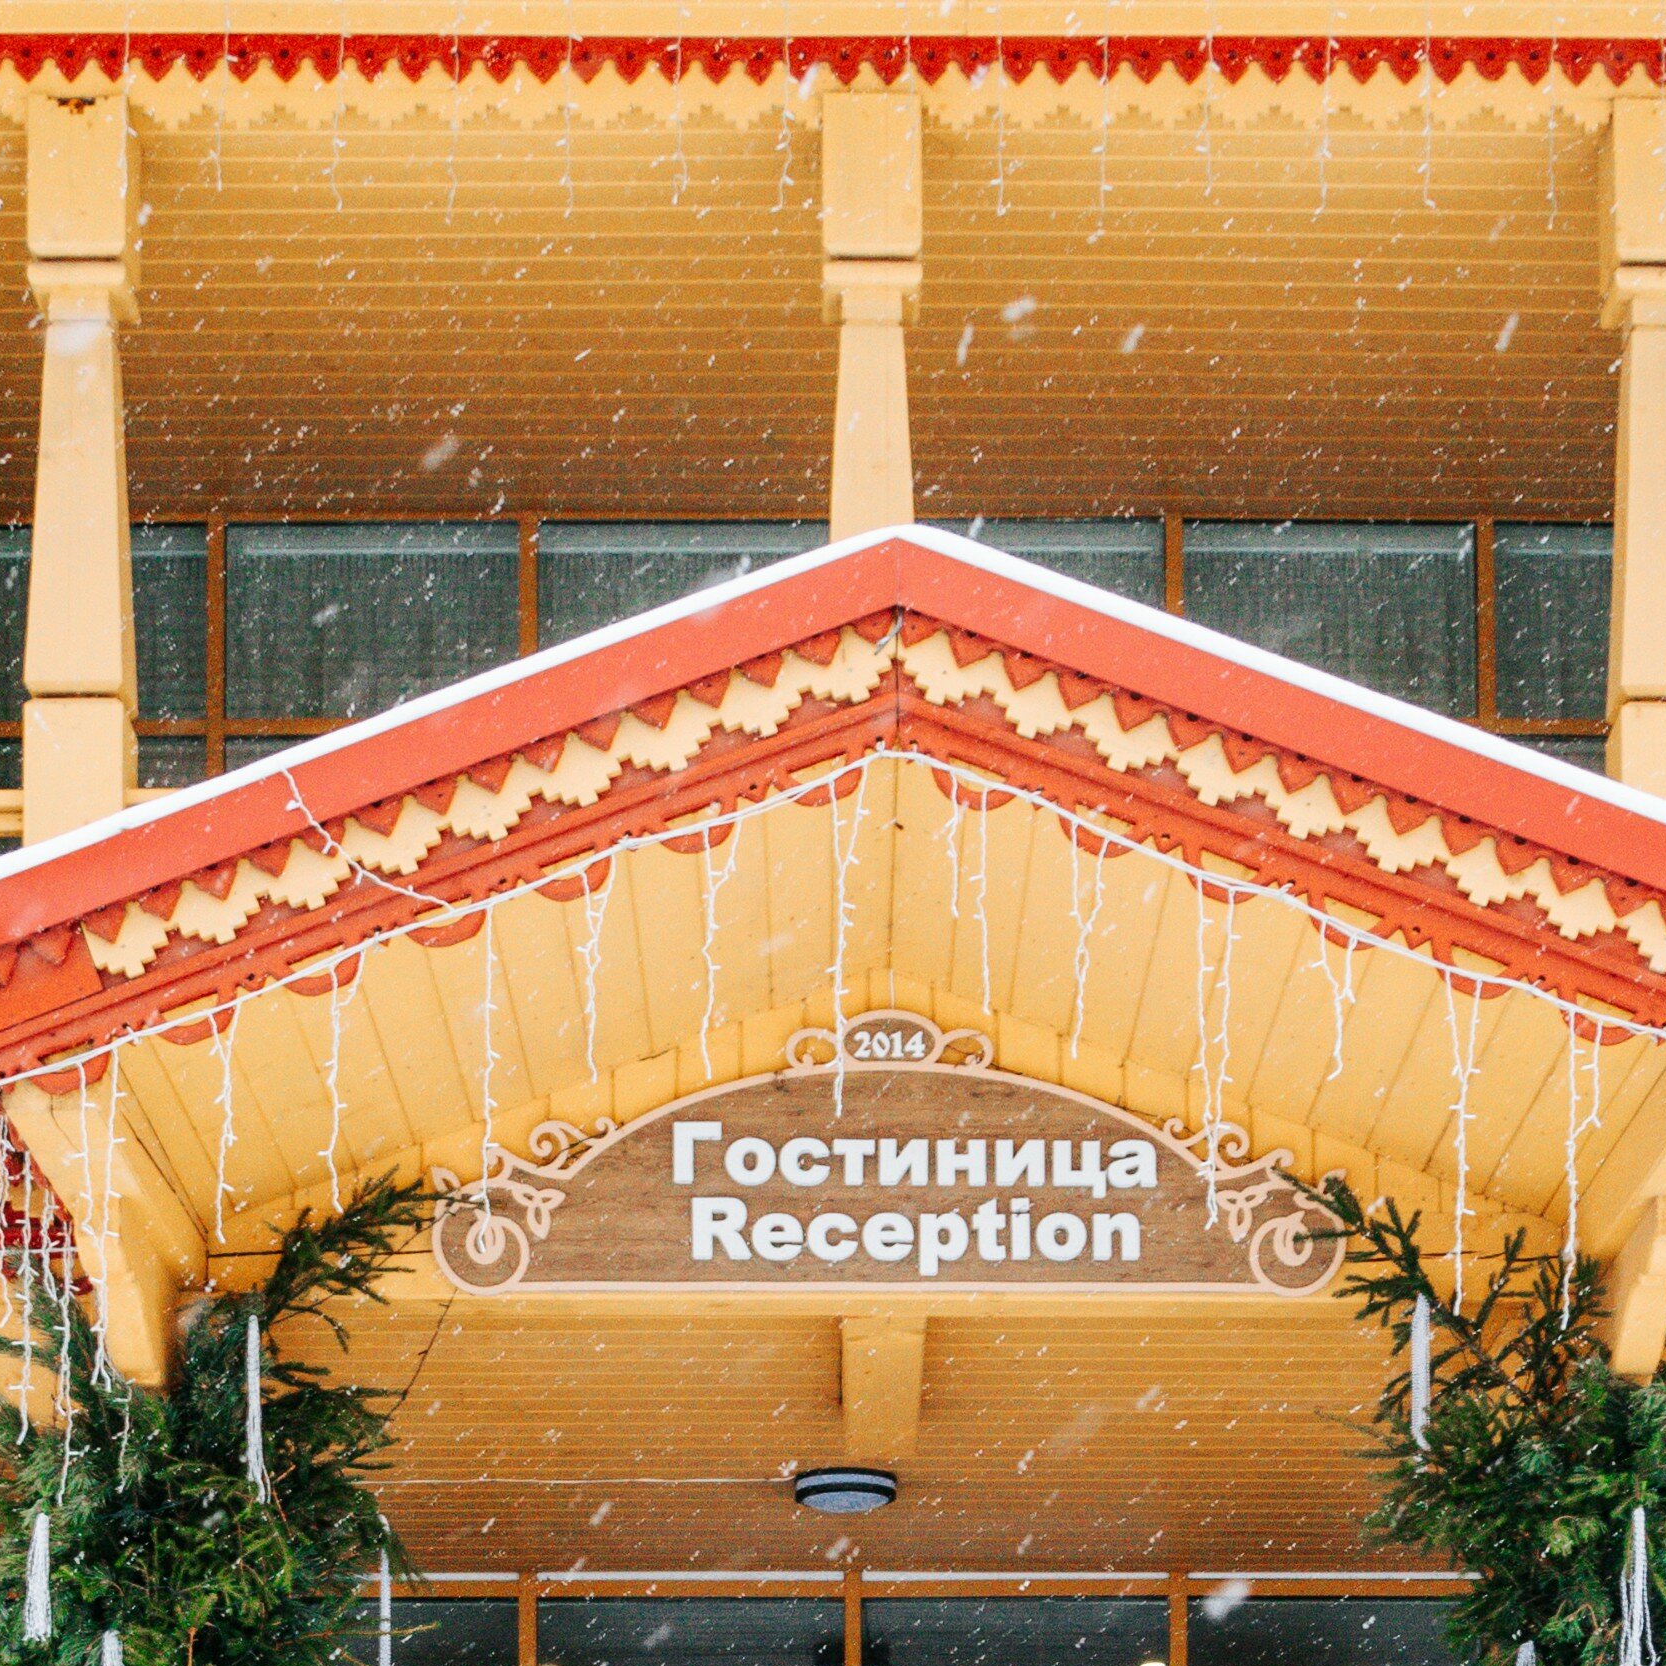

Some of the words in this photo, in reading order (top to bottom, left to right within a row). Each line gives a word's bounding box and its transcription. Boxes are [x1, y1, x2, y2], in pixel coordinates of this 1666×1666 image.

[853, 1031, 926, 1059] 2014
[671, 1120, 1159, 1197] Гостиница
[690, 1197, 1142, 1277] Reception
